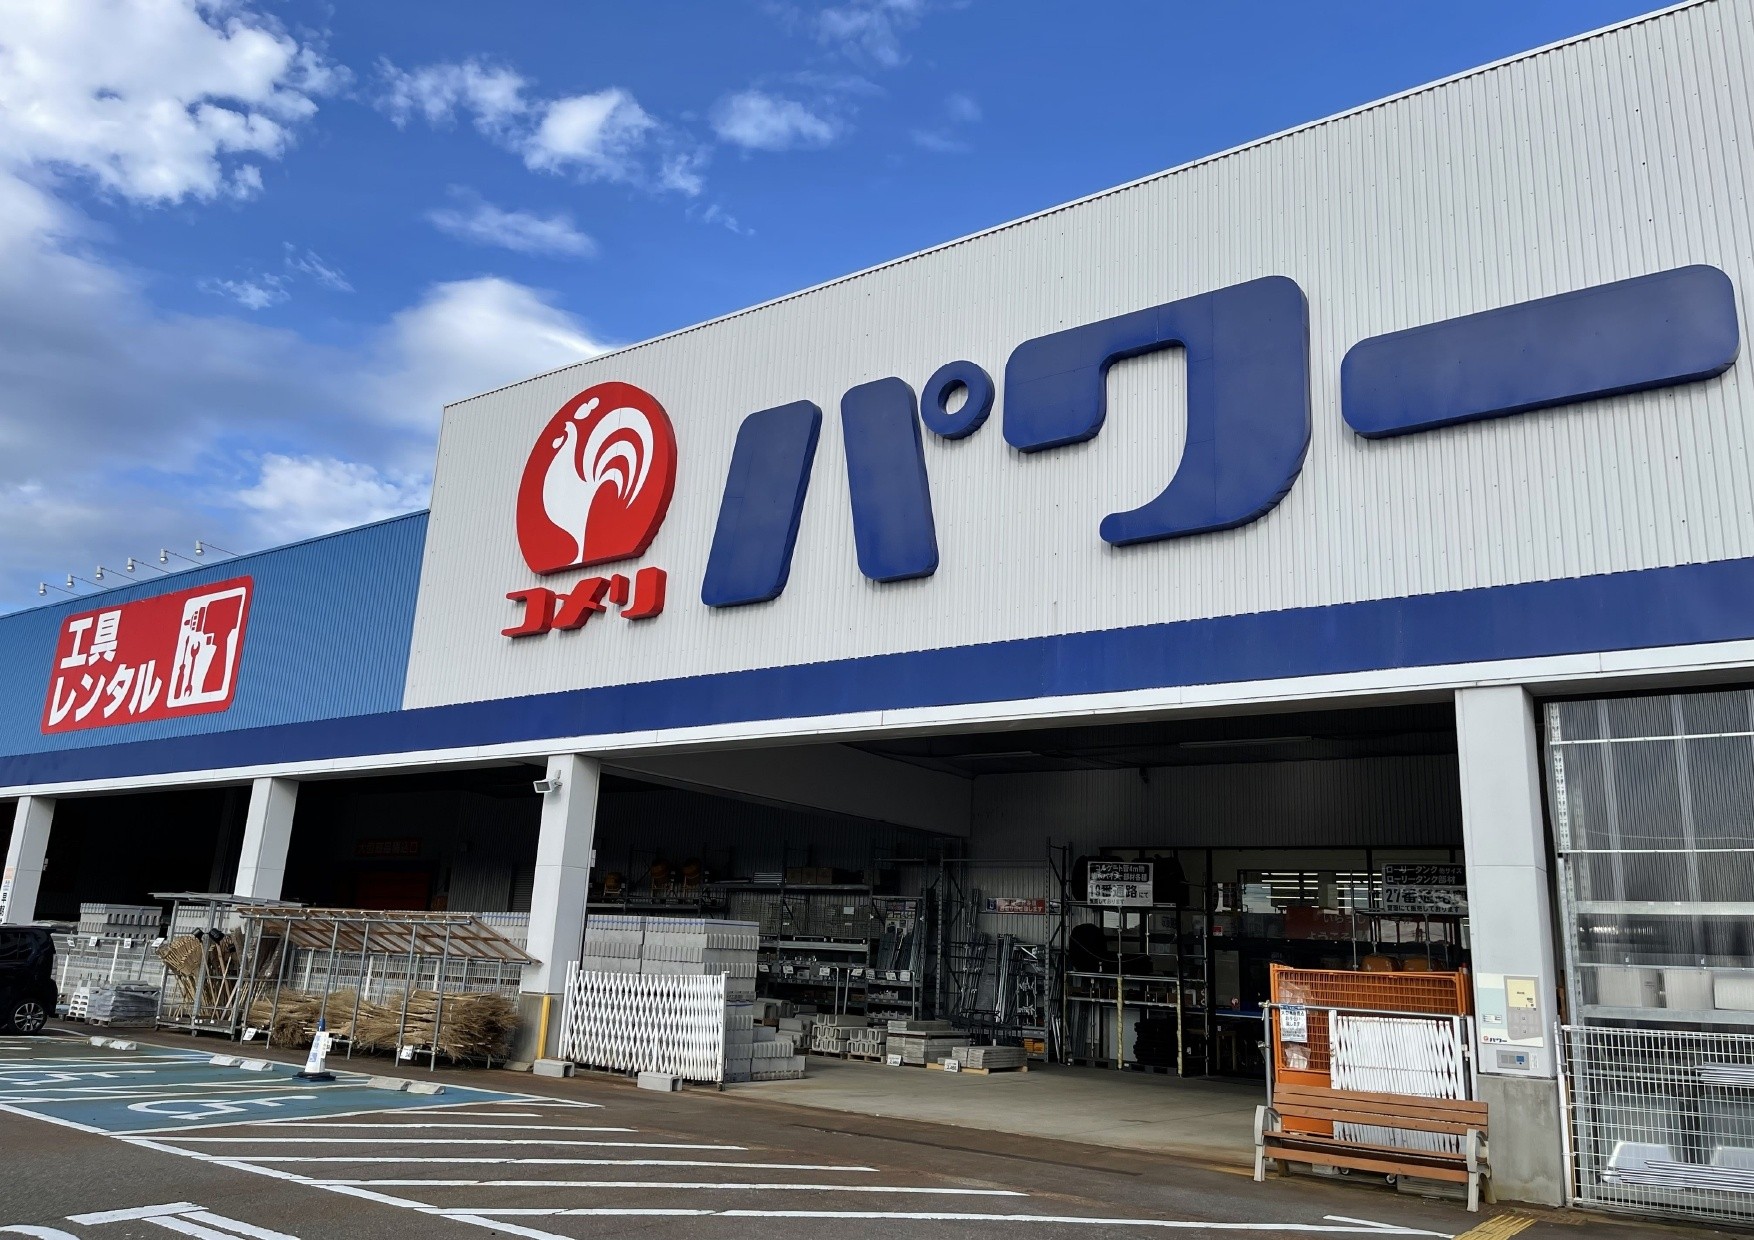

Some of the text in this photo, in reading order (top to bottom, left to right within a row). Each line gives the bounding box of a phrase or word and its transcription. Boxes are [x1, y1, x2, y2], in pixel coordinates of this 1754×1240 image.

[700, 263, 1740, 608] パワー
[501, 567, 667, 638] コメリ
[60, 609, 122, 669] 工具
[48, 660, 162, 726] レンタル
